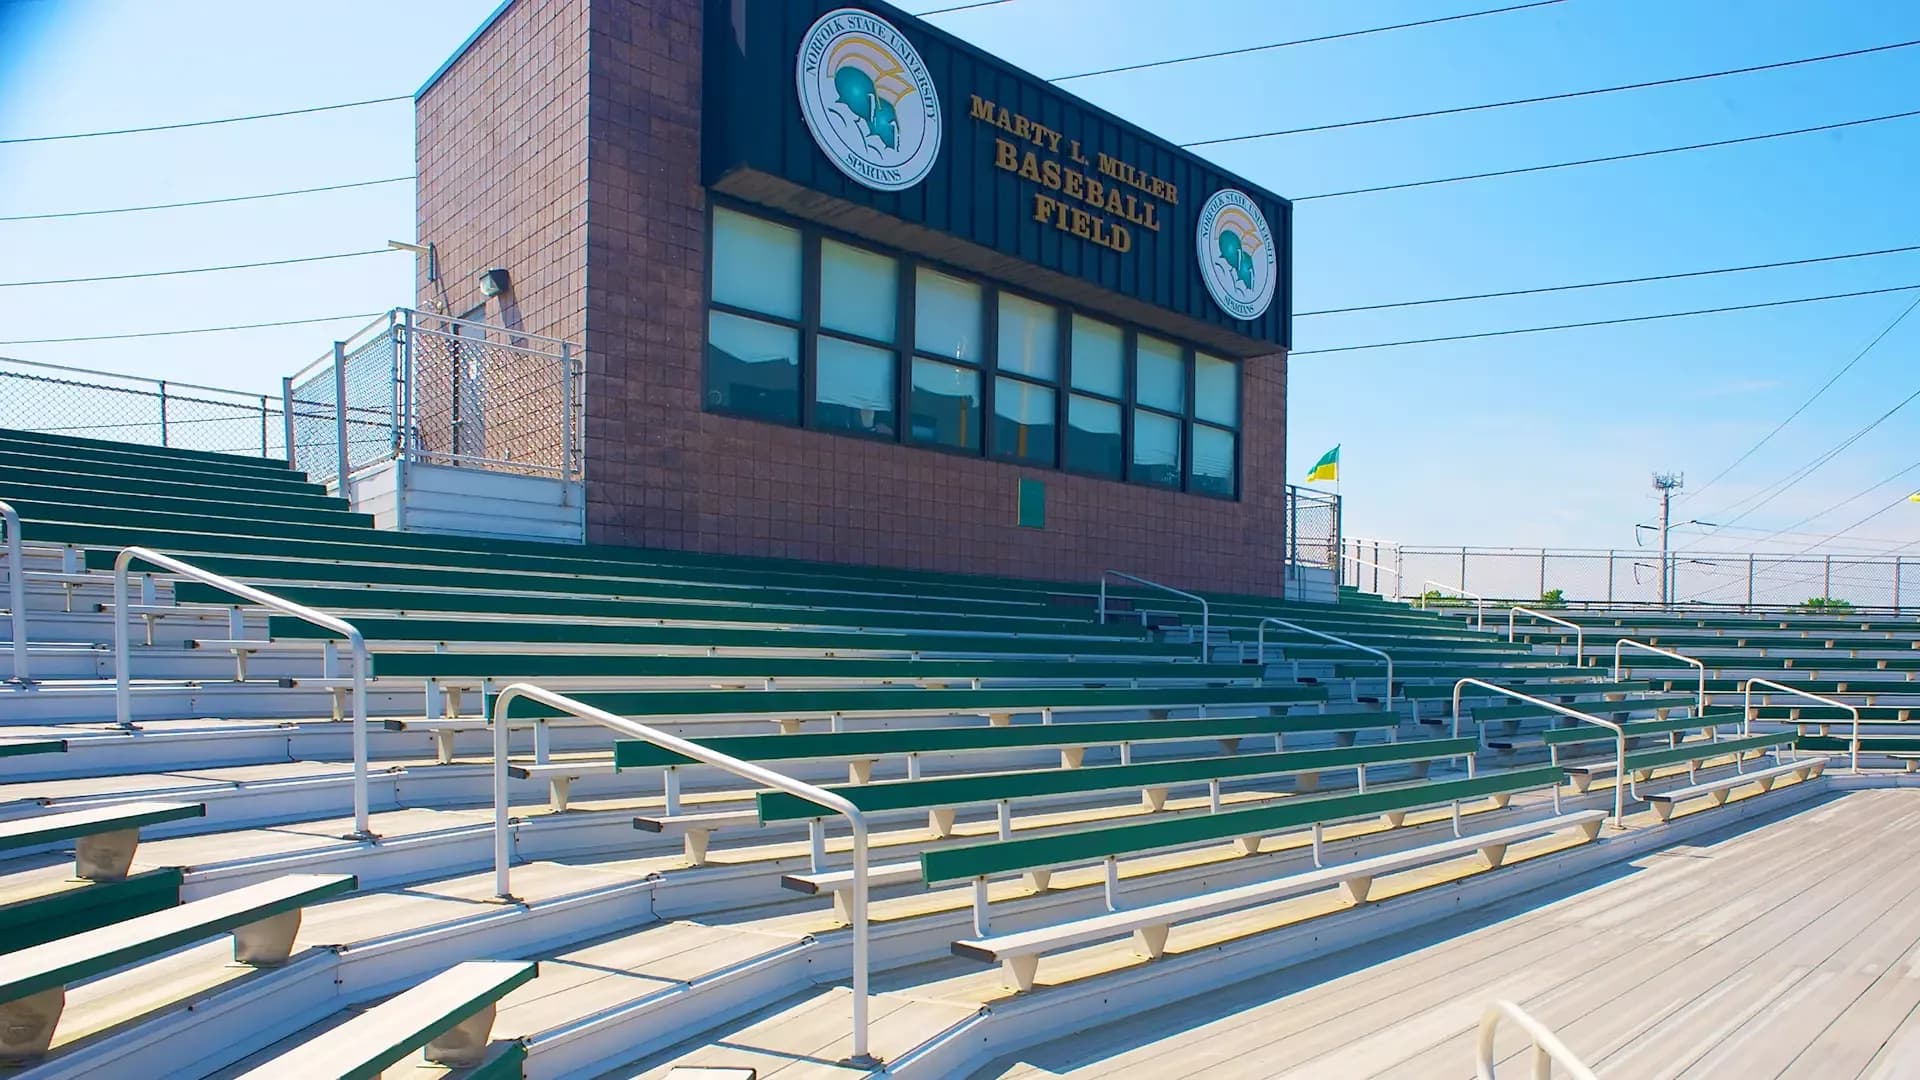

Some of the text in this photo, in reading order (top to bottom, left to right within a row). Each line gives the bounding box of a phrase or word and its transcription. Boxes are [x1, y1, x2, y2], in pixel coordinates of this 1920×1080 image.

[806, 16, 936, 122] NORFOLK STATE UNIVERSITY
[845, 153, 901, 181] SPARTANS
[970, 94, 1179, 205] MARTY L. MILLER
[995, 138, 1160, 232] BASEBALL
[1034, 193, 1131, 253] FIELD
[1202, 196, 1225, 239] NORFOLK
